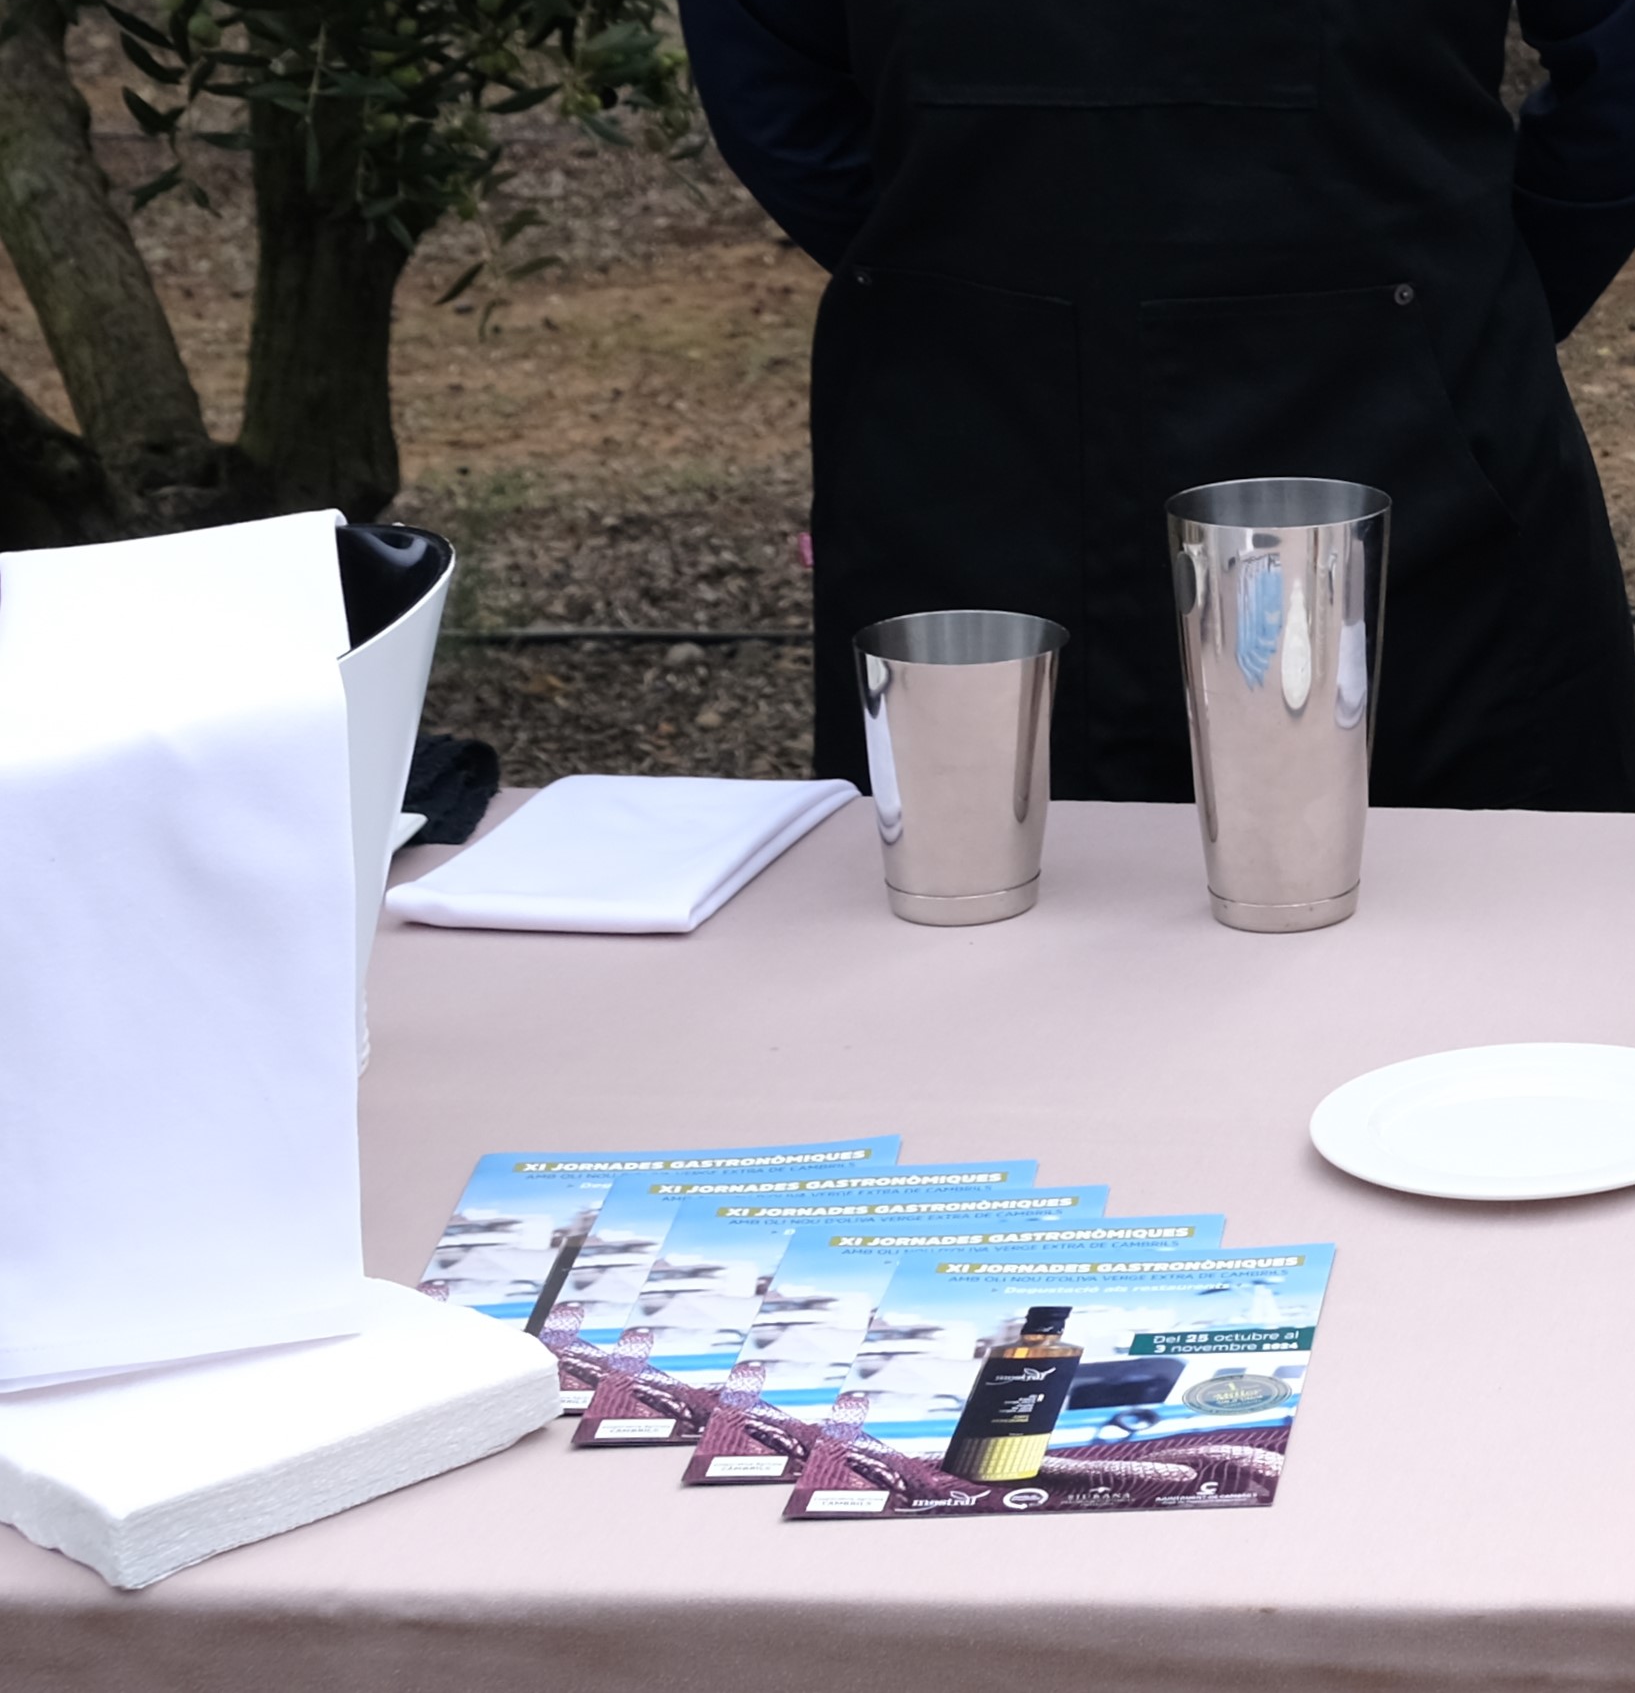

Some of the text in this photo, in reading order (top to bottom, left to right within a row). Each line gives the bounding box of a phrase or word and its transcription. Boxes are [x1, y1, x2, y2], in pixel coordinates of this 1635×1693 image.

[523, 1163, 547, 1172] XI
[551, 1161, 664, 1172] JORNADES
[658, 1185, 682, 1194] XI
[686, 1183, 800, 1194] JORNADES
[725, 1208, 749, 1216] XI
[755, 1205, 869, 1216] JORNADES
[838, 1237, 863, 1246] XI
[867, 1235, 983, 1246] JORNADES
[945, 1257, 1298, 1273] XI JORNADES GASTRONÒMIQUES
[1153, 1330, 1299, 1344] Del 25 octubre al
[1154, 1344, 1166, 1353] 3
[1171, 1343, 1257, 1352] novembre
